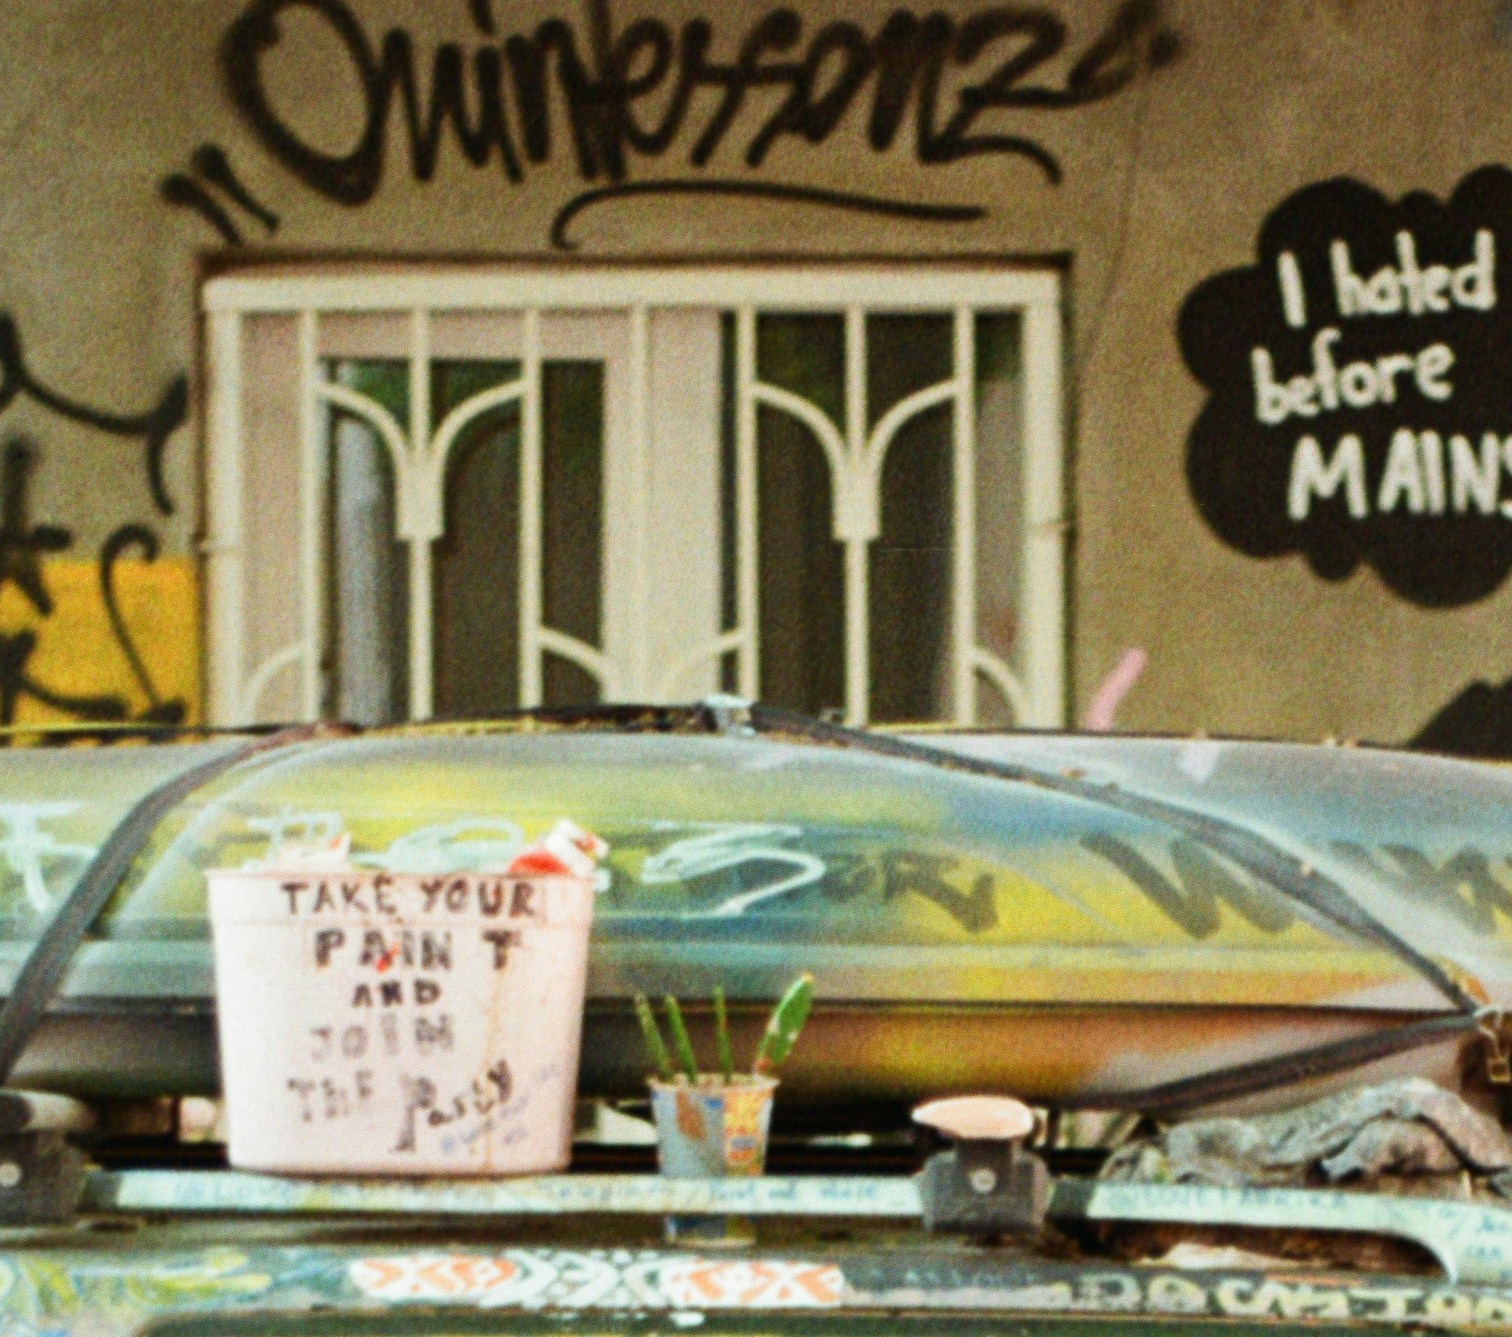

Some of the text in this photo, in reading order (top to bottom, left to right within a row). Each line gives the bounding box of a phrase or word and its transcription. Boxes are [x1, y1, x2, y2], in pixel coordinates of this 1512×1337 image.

[1276, 250, 1306, 329] I
[1330, 228, 1497, 318] hated
[1250, 327, 1456, 426] before
[279, 873, 538, 919] TAKE YOUR
[350, 977, 443, 1009] AND
